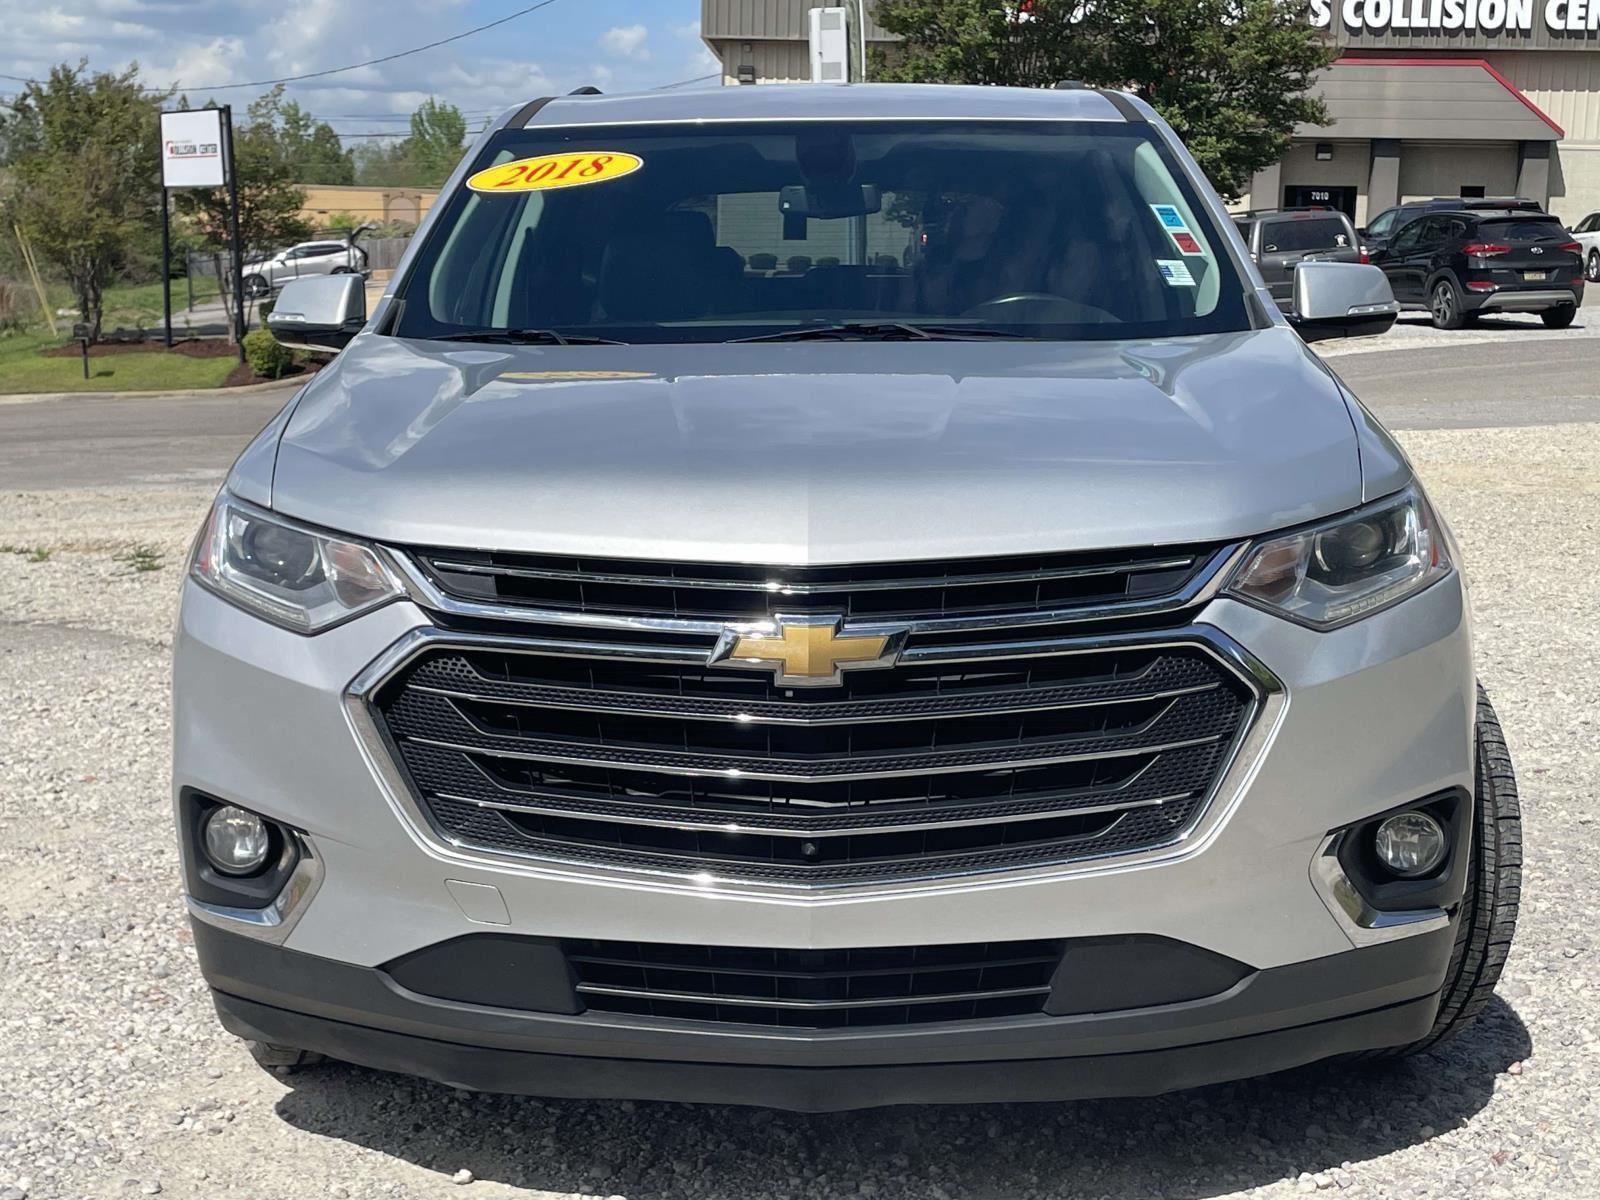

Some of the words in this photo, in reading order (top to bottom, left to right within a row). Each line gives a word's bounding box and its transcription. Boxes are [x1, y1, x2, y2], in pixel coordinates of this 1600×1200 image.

[1342, 0, 1532, 28] COLLISION
[494, 156, 613, 187] 2018
[1311, 191, 1329, 200] 7010
